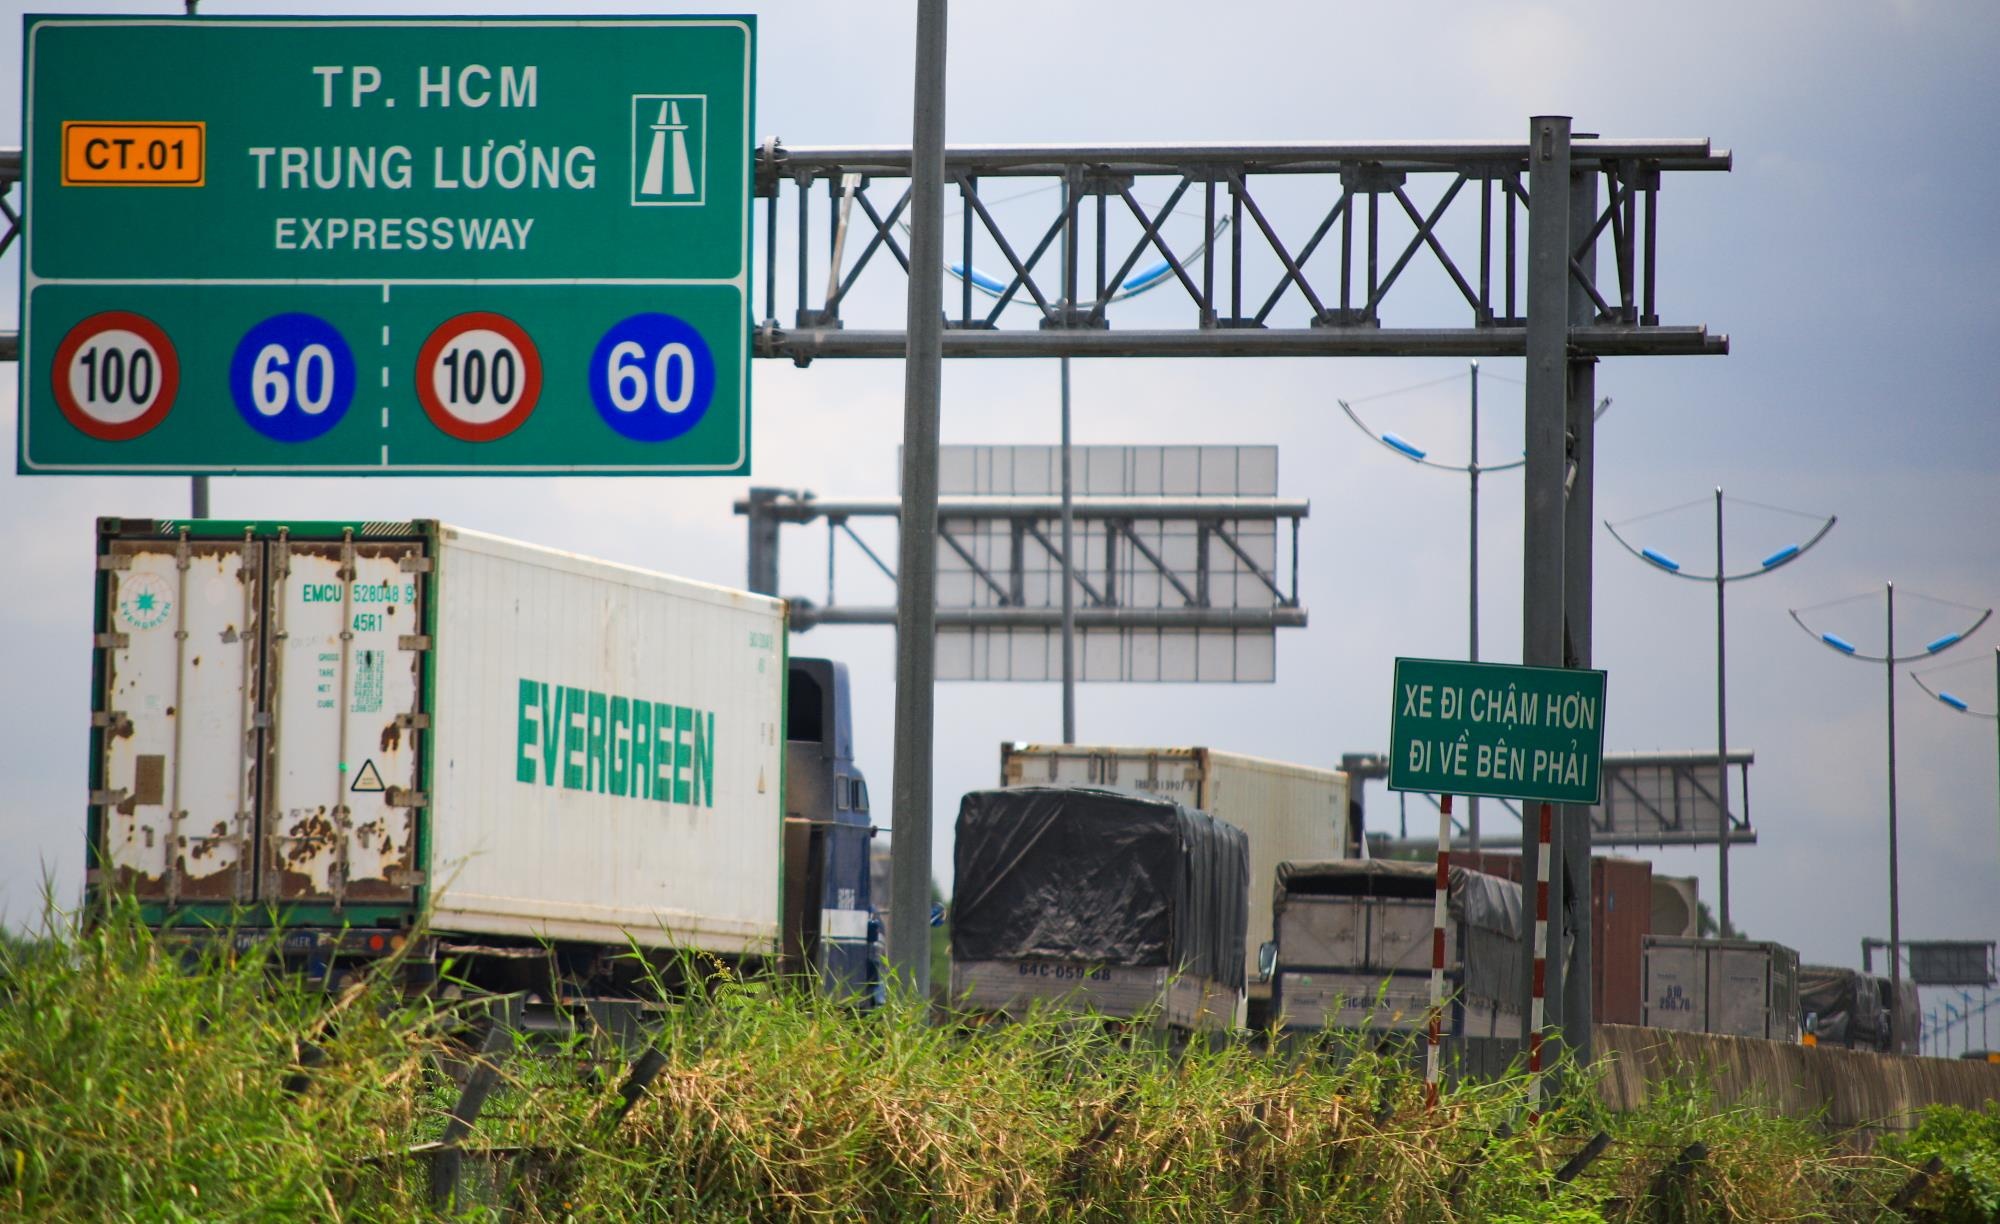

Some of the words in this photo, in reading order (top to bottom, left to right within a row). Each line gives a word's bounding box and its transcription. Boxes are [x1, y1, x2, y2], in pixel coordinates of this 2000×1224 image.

[313, 65, 396, 107] TP.
[419, 64, 538, 108] HCM
[84, 138, 185, 170] CT.01
[249, 145, 413, 189] TRUNG
[434, 139, 597, 190] LƯƠNG
[275, 217, 534, 250] EXPRESSWAY
[80, 346, 153, 405] 100
[252, 343, 335, 417] 60
[443, 348, 516, 406] 100
[607, 340, 695, 414] 60
[303, 583, 342, 602] EMCU
[353, 584, 399, 602] 528048
[353, 613, 382, 632] 45R1
[1403, 683, 1434, 718] XE
[1440, 686, 1463, 721] ĐI
[1470, 682, 1538, 731] CHẬM
[1545, 691, 1595, 730] HƠN
[516, 678, 715, 808] EVERGREEN
[1409, 739, 1431, 774] ĐI
[1440, 728, 1469, 776] VỀ
[1476, 737, 1526, 782] BÊN
[1532, 739, 1588, 787] PHẢI
